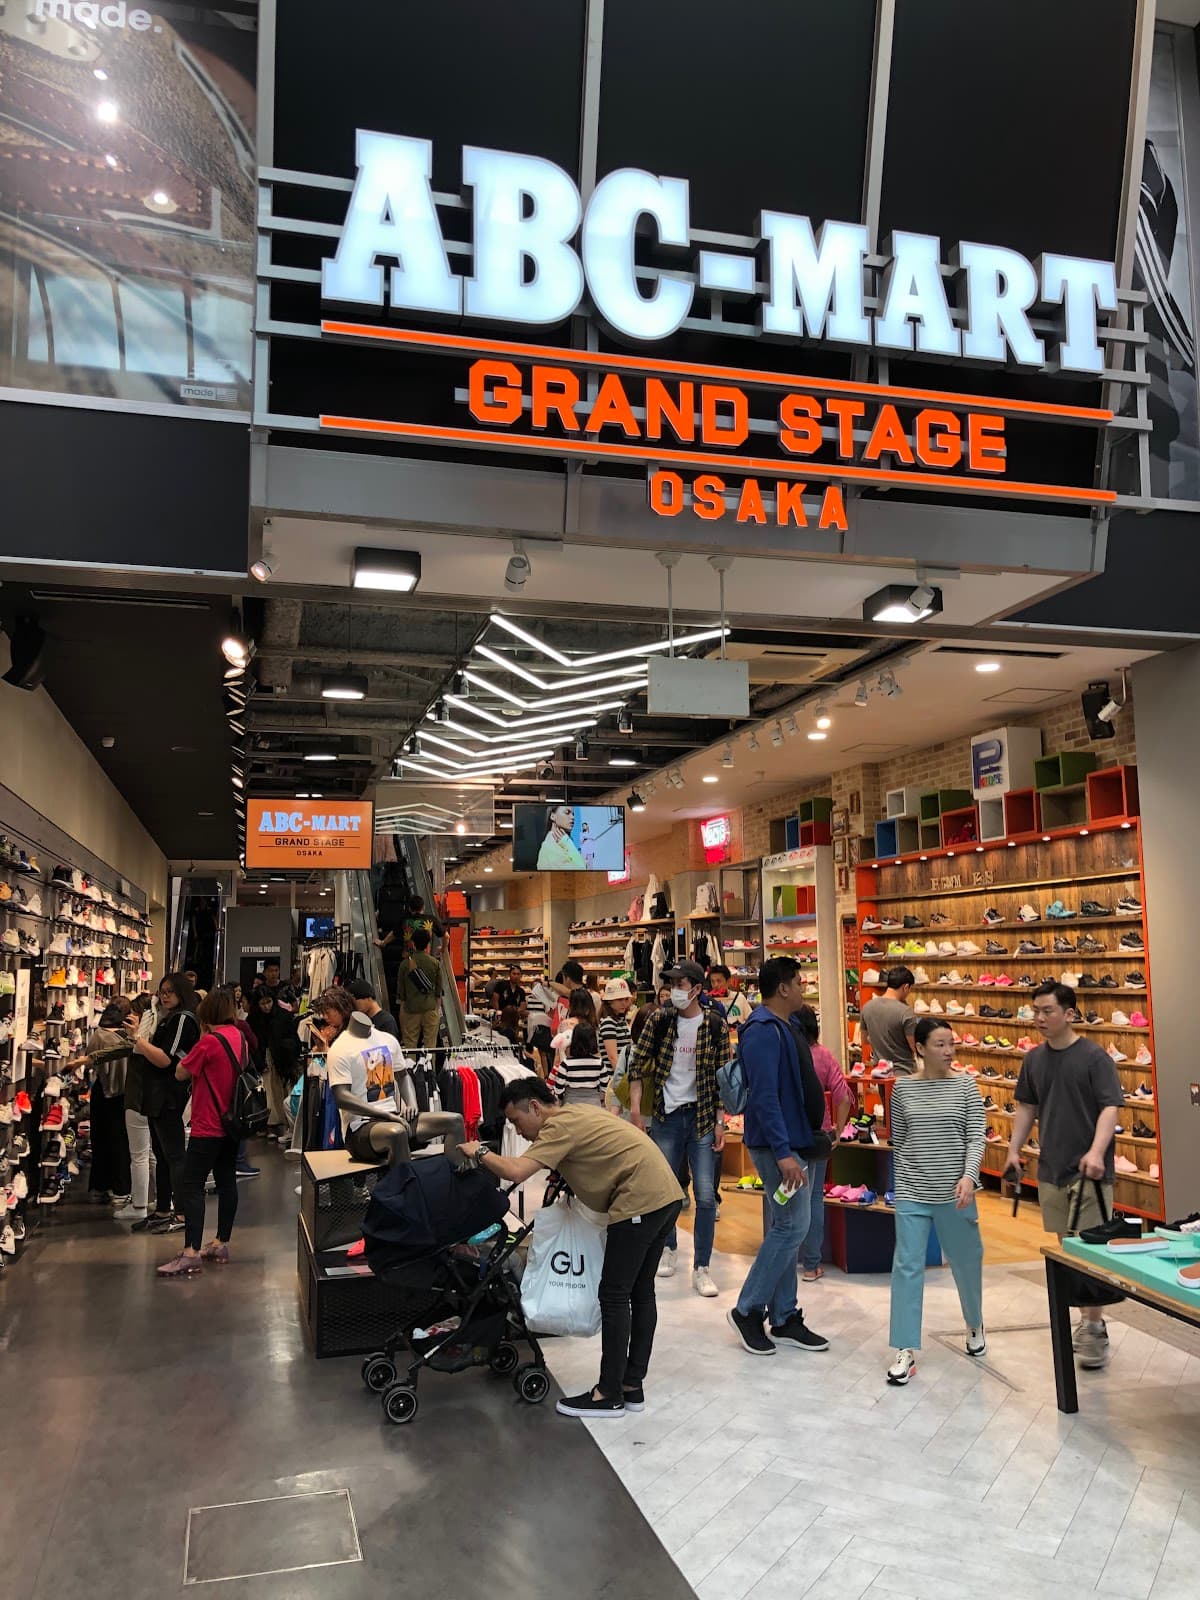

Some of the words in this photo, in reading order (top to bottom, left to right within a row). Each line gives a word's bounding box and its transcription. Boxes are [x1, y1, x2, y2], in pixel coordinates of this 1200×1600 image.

[35, 0, 162, 33] made.
[321, 128, 1118, 375] ABC-MART
[468, 358, 749, 447] GRAND
[779, 393, 1006, 473] STAGE
[650, 470, 848, 531] OSAKA
[258, 811, 361, 832] ABC-MART
[275, 837, 310, 846] GRAND
[313, 838, 345, 847] STAGE
[551, 1250, 585, 1276] GU
